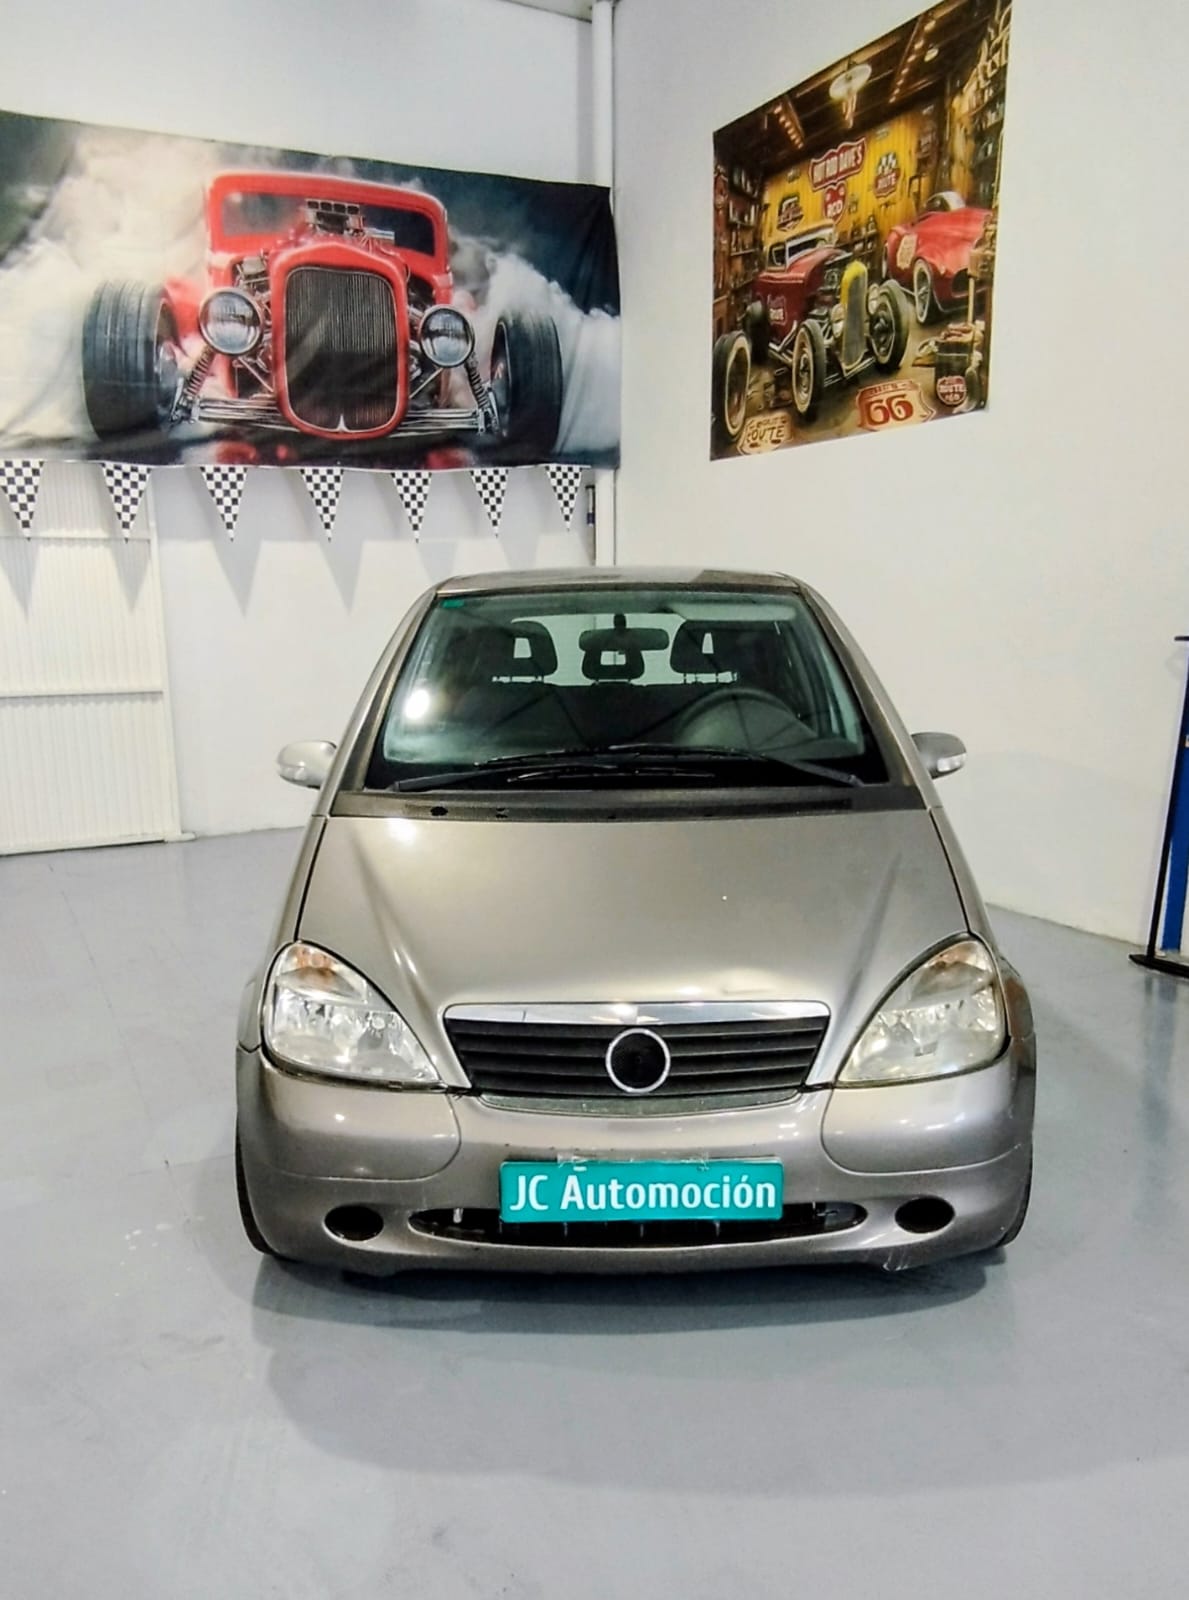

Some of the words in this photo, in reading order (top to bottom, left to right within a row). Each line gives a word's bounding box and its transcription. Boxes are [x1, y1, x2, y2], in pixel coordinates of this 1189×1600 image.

[867, 394, 914, 426] 66
[511, 1175, 549, 1211] JC
[561, 1175, 776, 1210] Automoción
